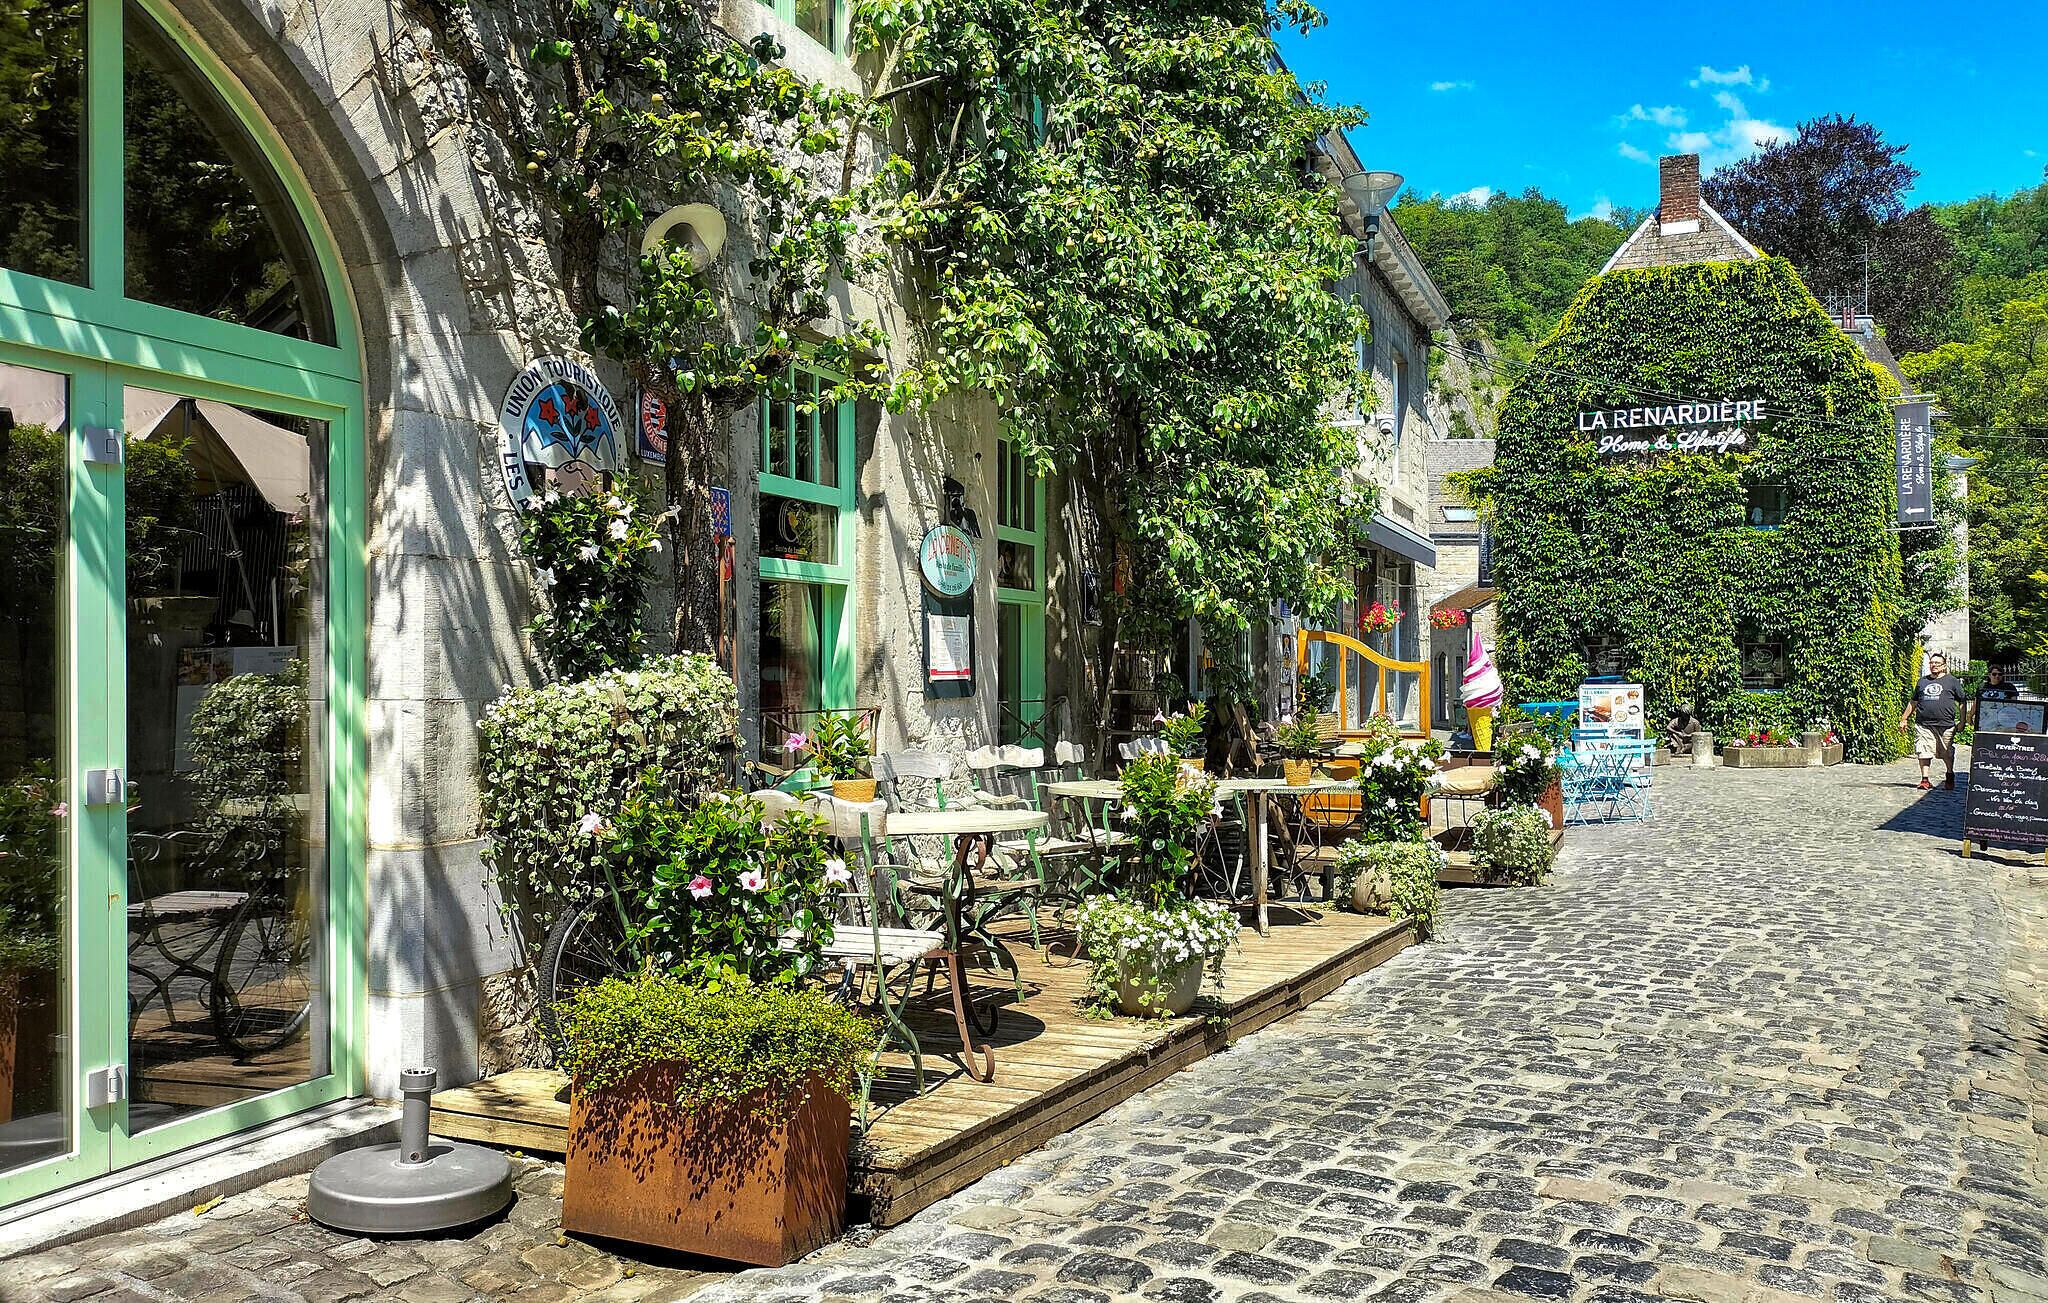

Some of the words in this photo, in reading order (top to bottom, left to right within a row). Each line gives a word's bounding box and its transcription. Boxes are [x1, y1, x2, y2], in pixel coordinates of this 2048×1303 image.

[505, 366, 544, 418] UNION
[543, 360, 622, 433] TOURISTIQUE
[1579, 410, 1607, 431] LA
[1613, 397, 1767, 429] RENARDIÈRE
[1598, 434, 1650, 454] Home
[1653, 435, 1673, 451] &
[1676, 428, 1747, 454] Lifestyle
[502, 452, 525, 491] LES
[1902, 481, 1913, 495] LA
[1995, 743, 2035, 752] FEVER-TREE
